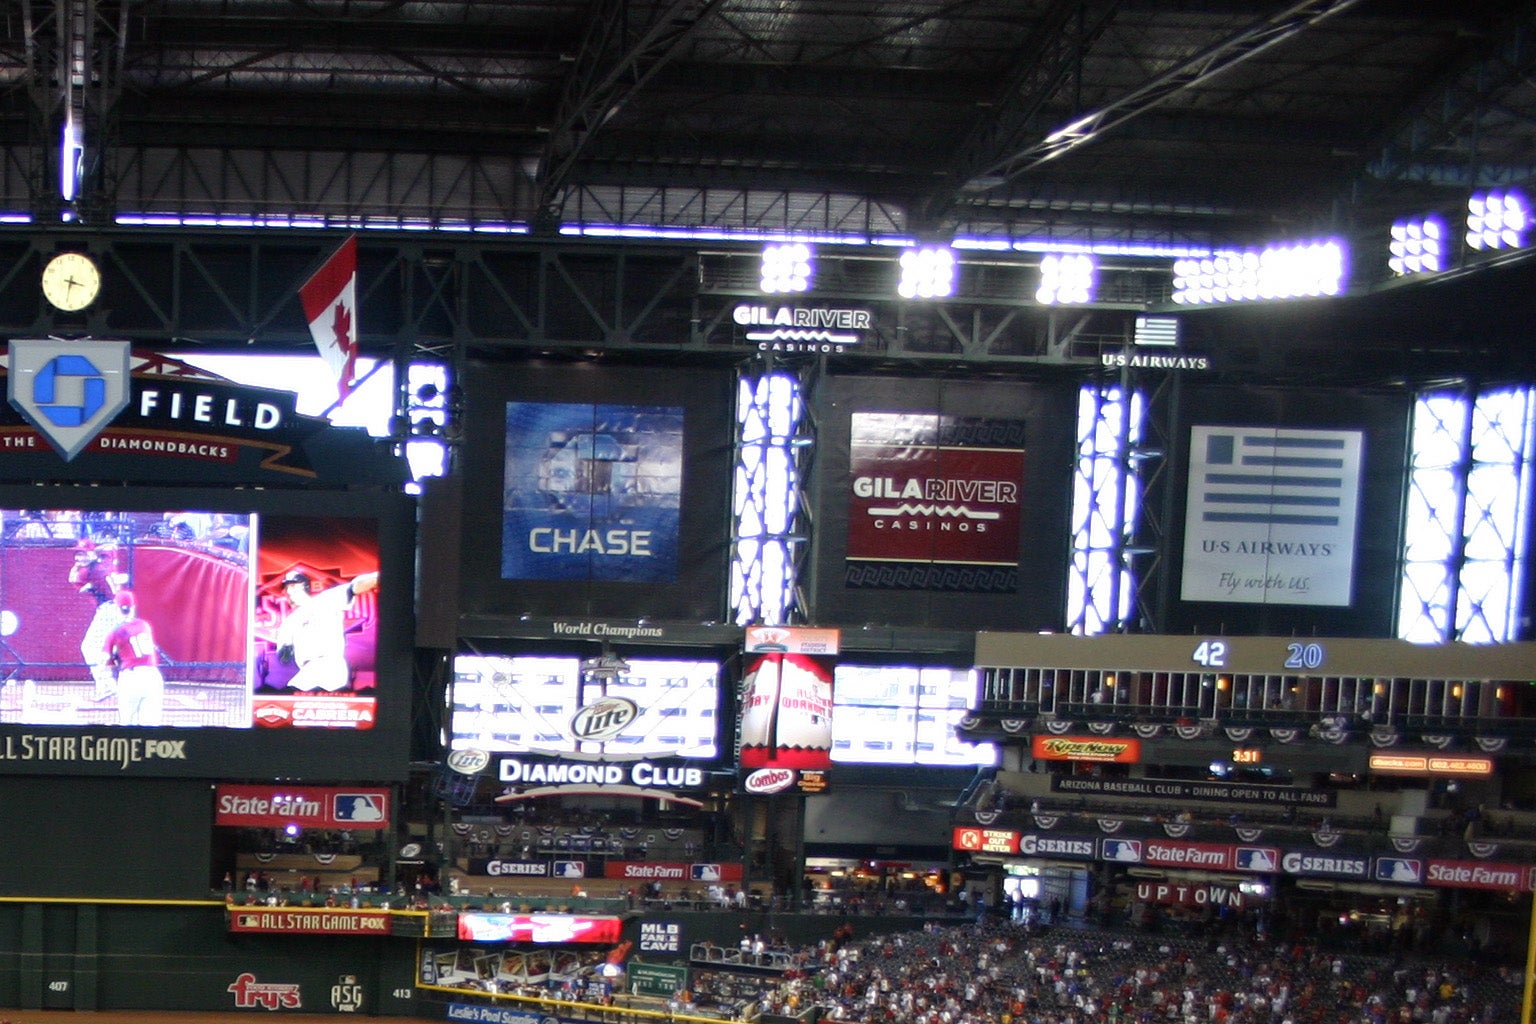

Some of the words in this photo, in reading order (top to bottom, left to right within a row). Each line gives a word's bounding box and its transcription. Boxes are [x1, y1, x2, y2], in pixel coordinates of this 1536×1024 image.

[758, 343, 844, 353] CASINOS
[1129, 355, 1207, 370] AIRWAYS
[141, 389, 282, 431] FIELD
[3, 435, 36, 448] THE
[100, 436, 229, 459] DIAMONDBACKS
[874, 519, 987, 533] CASINOS
[528, 527, 652, 556] CHASE
[1235, 541, 1333, 557] AIRWAYS
[1219, 572, 1240, 596] Fly
[1250, 573, 1285, 590] with
[552, 622, 591, 635] World
[593, 623, 663, 638] Champions
[1192, 641, 1225, 667] 42
[1284, 642, 1323, 669] 20
[291, 708, 373, 722] CABRERA
[583, 706, 628, 738] Lite
[20, 734, 77, 761] STAR
[80, 735, 142, 770] GAME
[145, 739, 187, 760] FOX
[459, 753, 484, 767] Lite
[1232, 750, 1257, 763] 3:31
[498, 759, 623, 784] DIAMOND
[631, 761, 703, 786] CLUB
[748, 770, 790, 788] Combos
[1059, 779, 1101, 791] ARIZONA
[1103, 781, 1152, 794] BASEBALL
[1154, 783, 1182, 795] CLUB
[1192, 786, 1229, 798] DINING
[1231, 787, 1260, 800] OPEN
[1263, 790, 1277, 800] TO
[1278, 790, 1298, 802] ALL
[1300, 791, 1328, 804] FANS
[982, 844, 1011, 853] METER
[988, 837, 1006, 845] OUT
[1020, 835, 1037, 855] G
[1037, 837, 1092, 856] SERIES
[501, 862, 546, 876] SERIES
[1282, 853, 1302, 873] G
[1302, 856, 1364, 875] SERIES
[1138, 884, 1242, 907] UPTOWN
[261, 913, 285, 929] ALL
[287, 913, 321, 930] STAR
[322, 914, 358, 930] GAME
[360, 917, 385, 930] FOX
[640, 923, 679, 934] MLB
[640, 941, 679, 952] CAVE
[47, 981, 69, 993] 407
[227, 972, 302, 1011] fry's
[392, 988, 412, 999] 413
[448, 1004, 479, 1020] Leslie's
[481, 1009, 500, 1022] Pool
